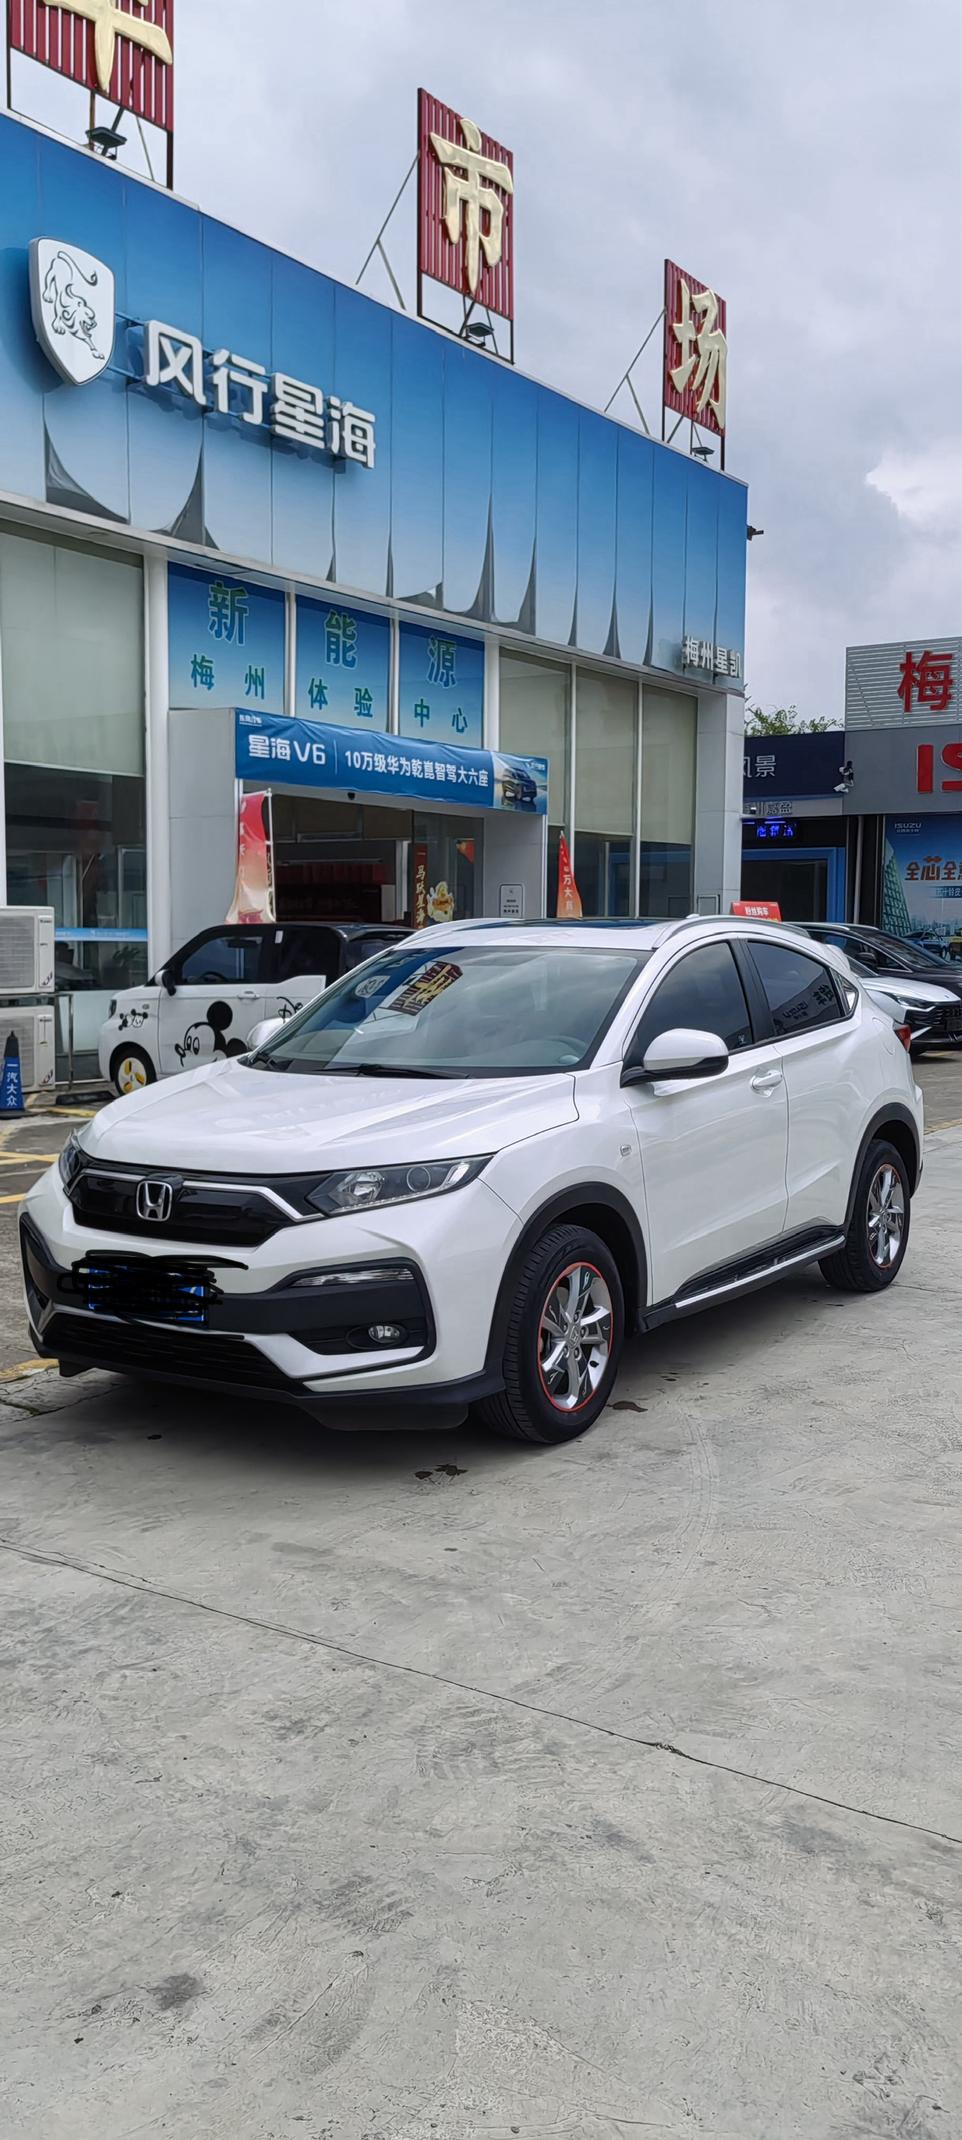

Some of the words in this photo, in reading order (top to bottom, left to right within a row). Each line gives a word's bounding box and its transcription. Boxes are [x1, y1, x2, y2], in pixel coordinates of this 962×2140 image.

[430, 117, 514, 297] 市
[669, 277, 728, 430] 场
[143, 319, 377, 470] 风行星海
[682, 635, 741, 678] 梅州星凯
[897, 650, 955, 713] 梅
[248, 734, 326, 764] 星海V6
[905, 855, 962, 881] 全芯全
[6, 1063, 19, 1107] 一汽大众
